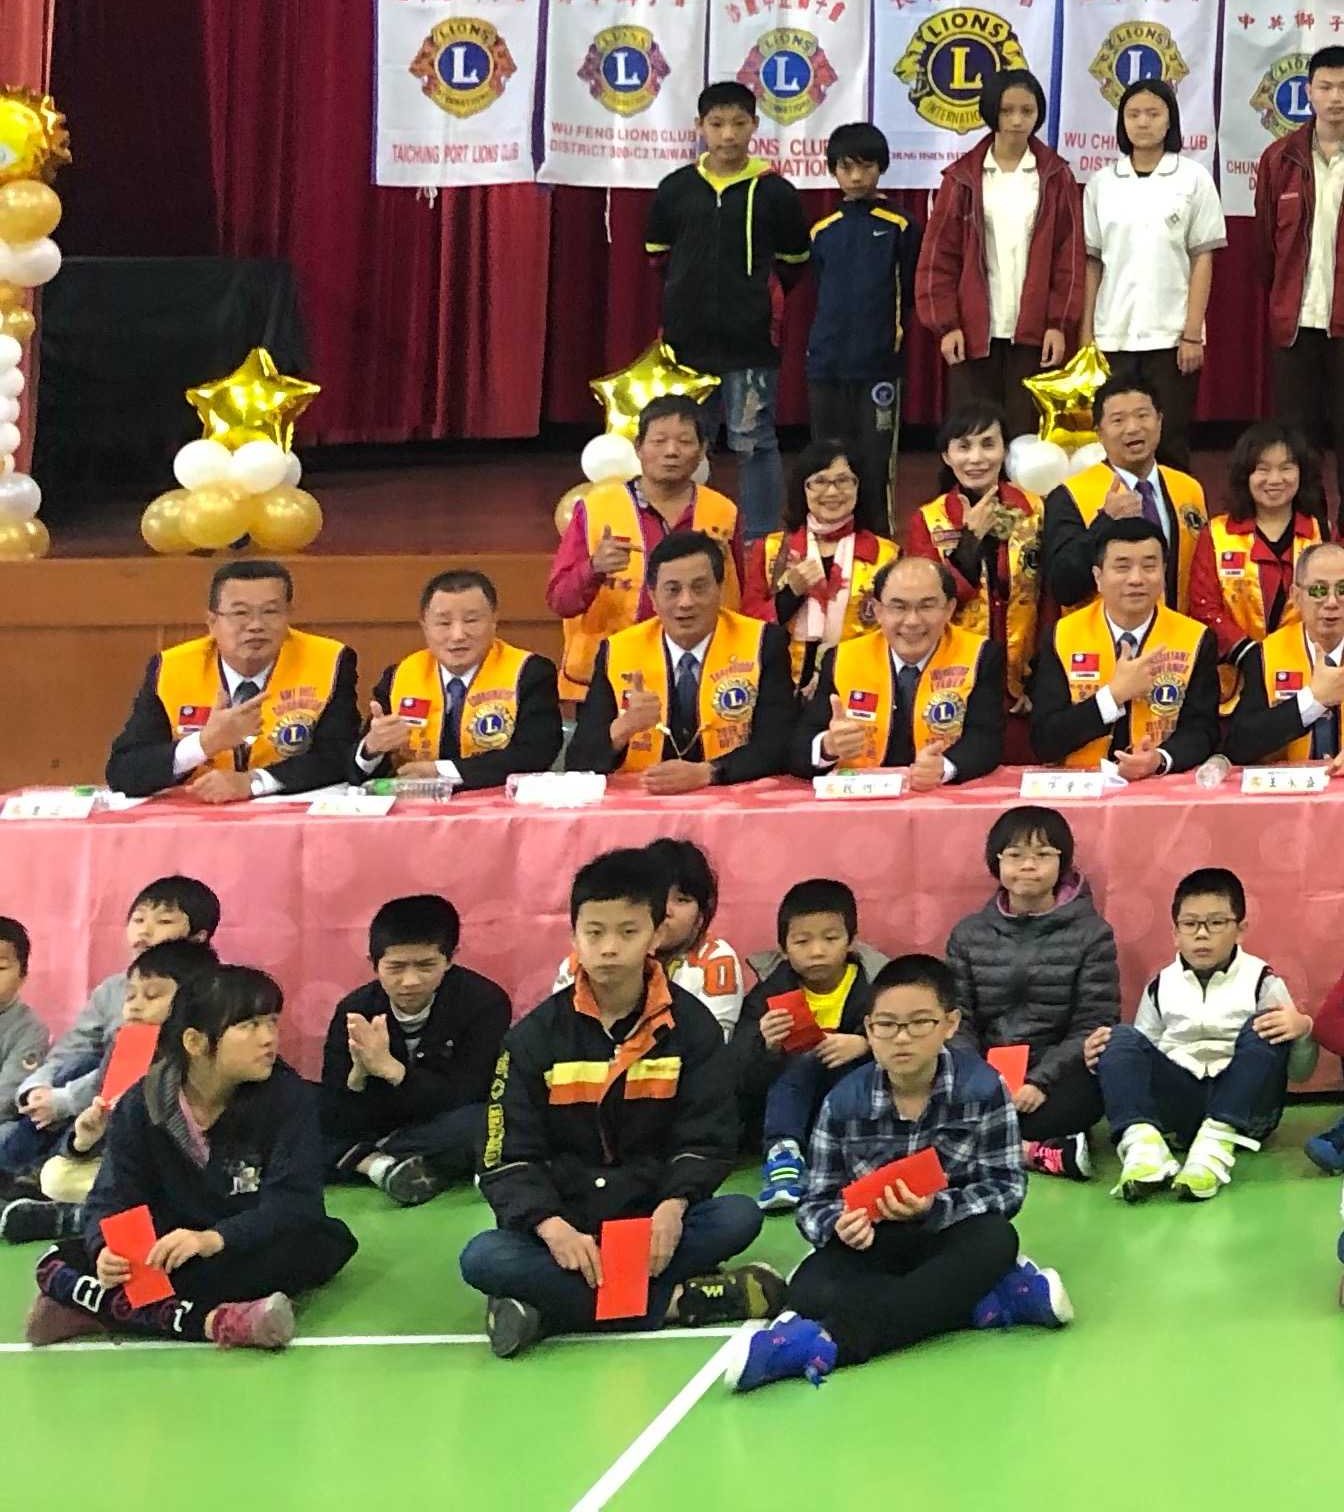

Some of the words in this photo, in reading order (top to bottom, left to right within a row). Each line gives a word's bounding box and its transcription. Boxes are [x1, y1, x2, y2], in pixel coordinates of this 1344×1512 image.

[927, 11, 1005, 39] LIONS
[1117, 26, 1165, 43] LIONS
[452, 46, 478, 84] L
[613, 52, 641, 86] L
[950, 47, 983, 89] L
[551, 122, 571, 136] WU
[576, 123, 614, 140] FENG
[618, 124, 657, 142] LIONS
[661, 125, 697, 143] CLUB
[1064, 131, 1087, 148] WU
[1182, 134, 1208, 150] LUB
[392, 143, 440, 164] TAICHUNG
[444, 143, 468, 164] PORT
[472, 144, 499, 164] LIONS
[550, 139, 606, 158] DISTRICT
[748, 138, 779, 157] ONS
